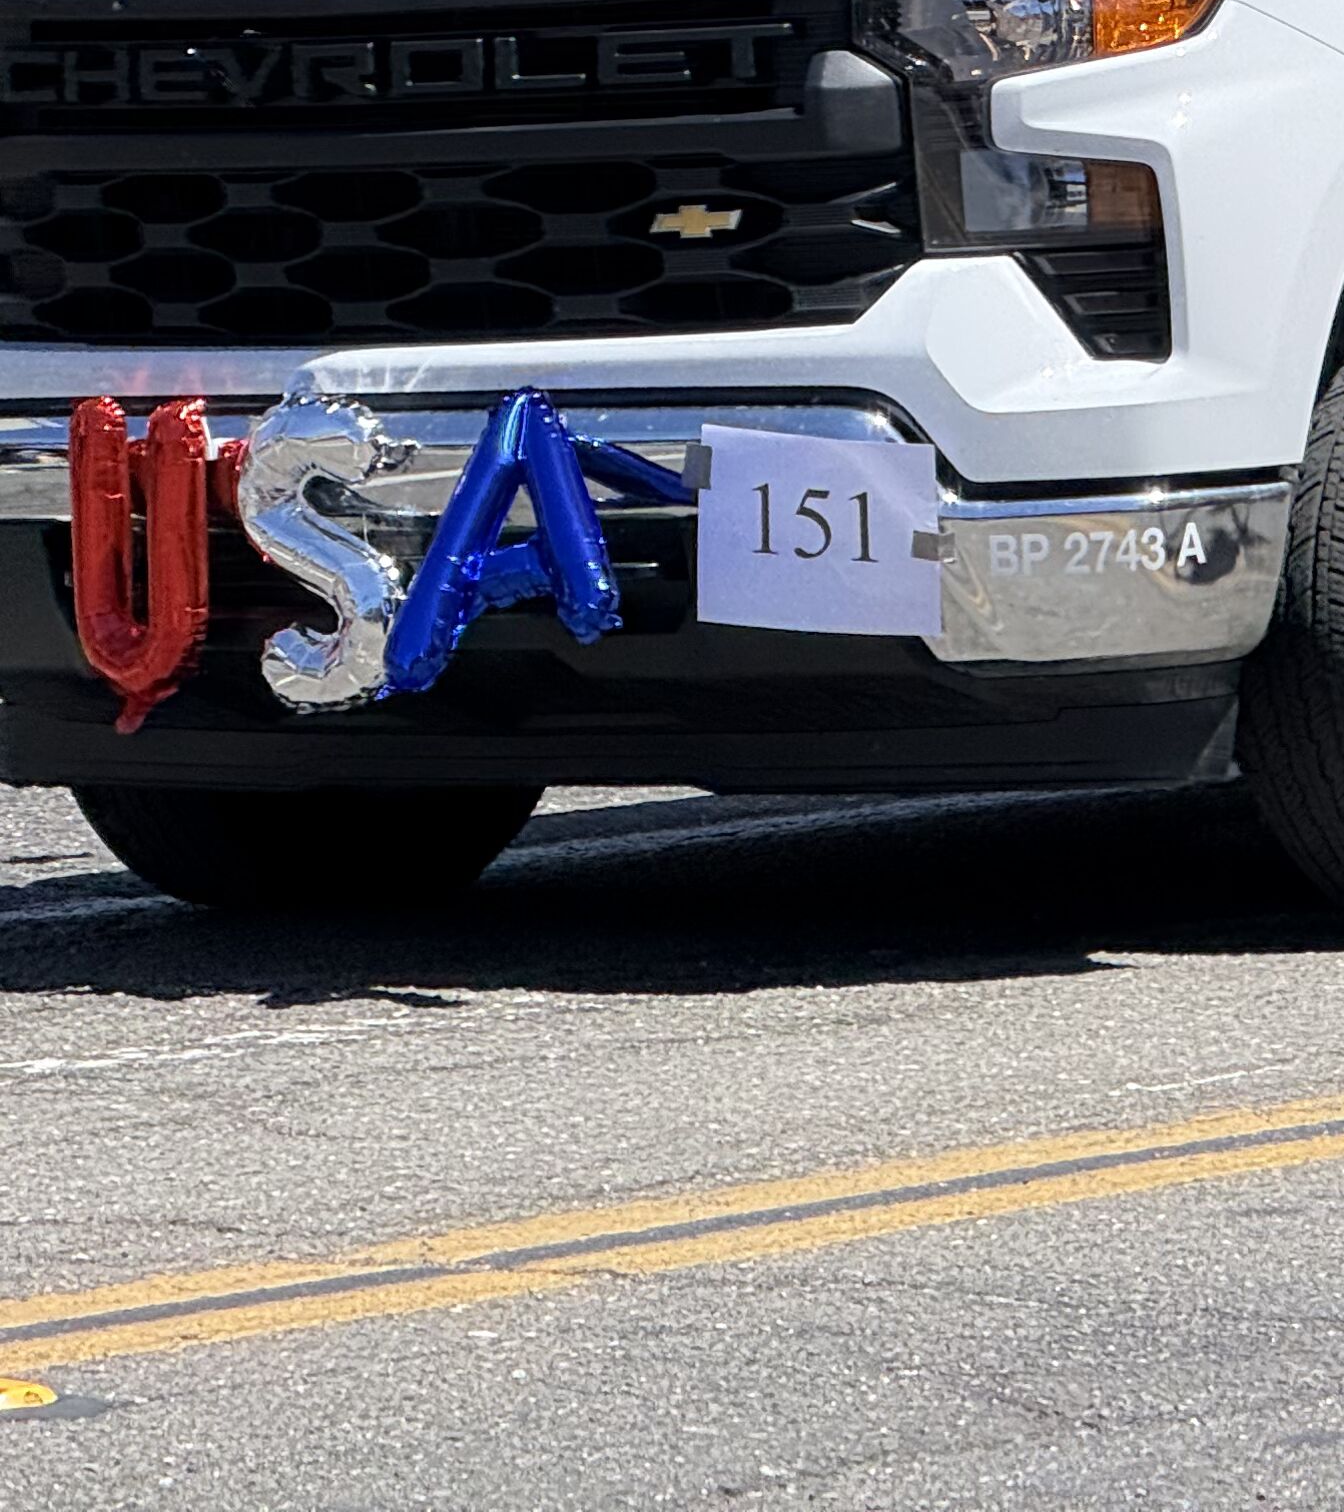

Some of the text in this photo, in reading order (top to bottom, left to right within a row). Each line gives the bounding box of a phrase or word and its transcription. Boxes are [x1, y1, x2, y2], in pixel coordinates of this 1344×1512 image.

[0, 22, 793, 109] CHEVROLET
[68, 385, 624, 735] USA
[753, 482, 878, 564] 151
[988, 522, 1208, 576] BP 2743 A
